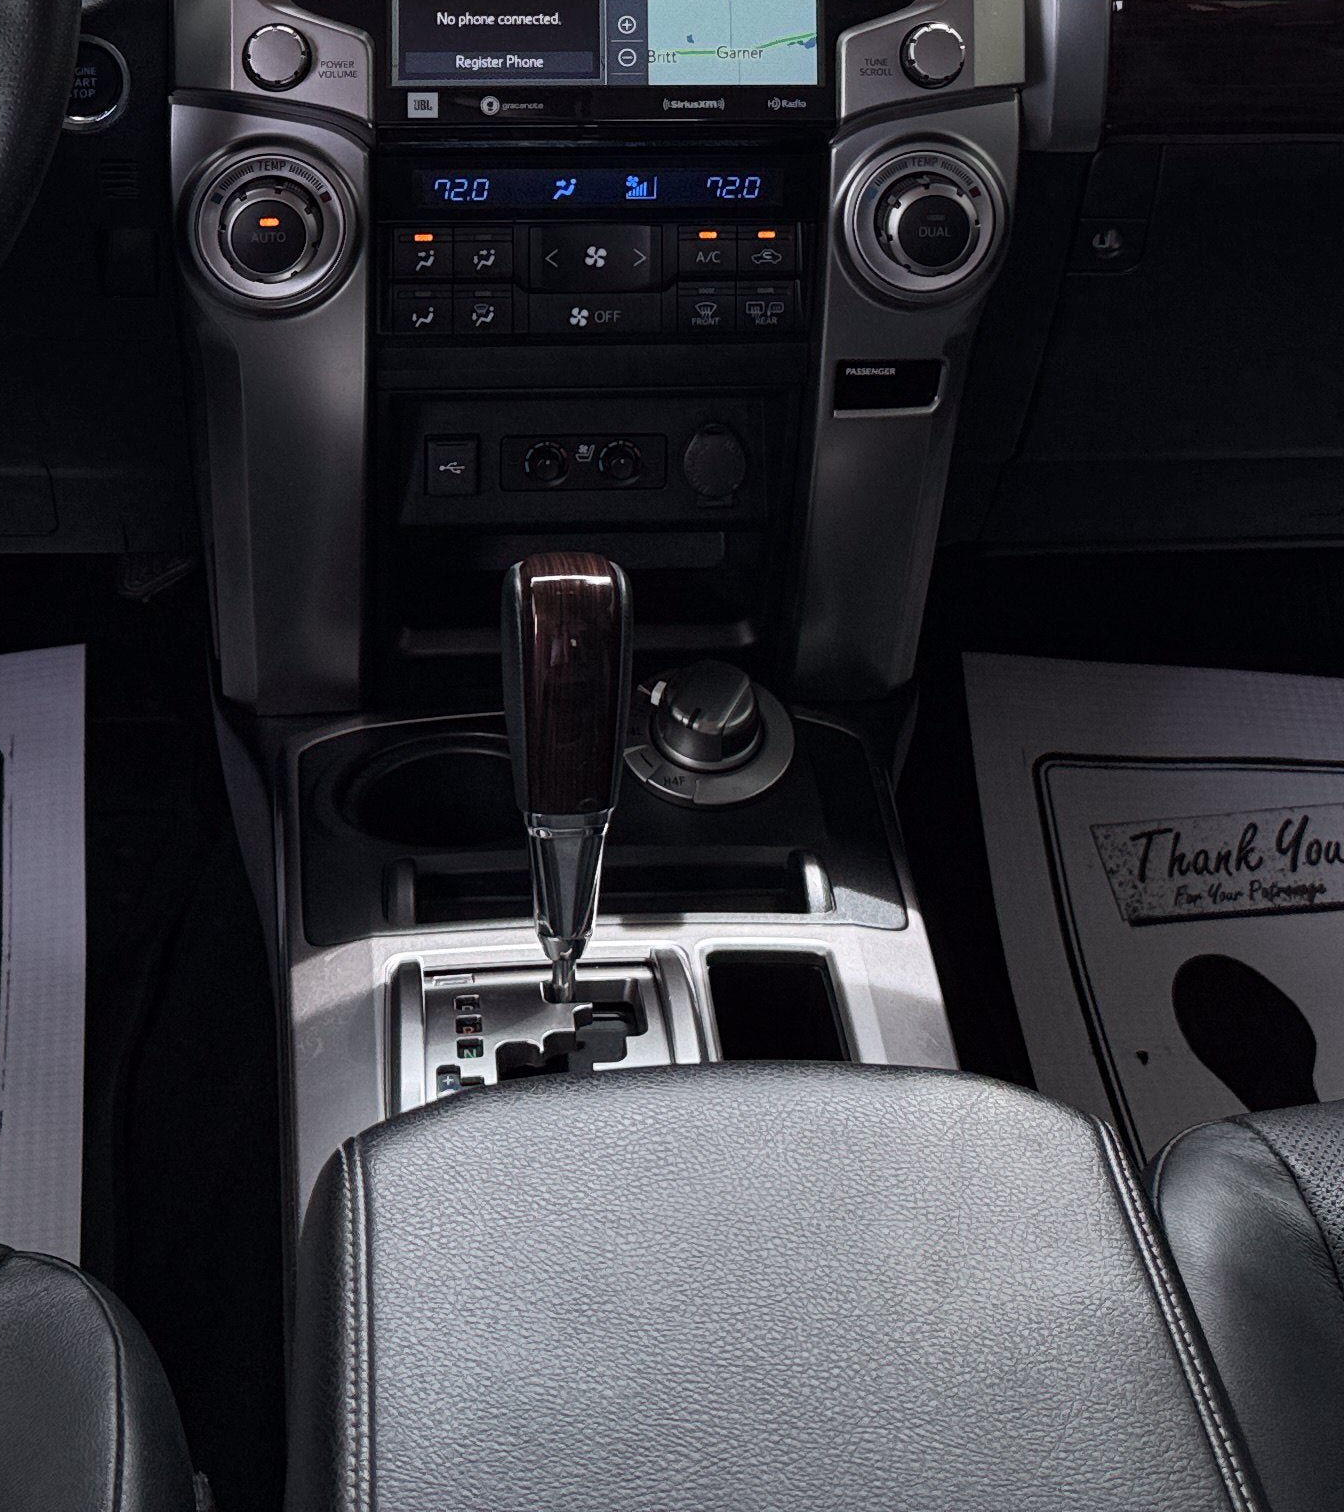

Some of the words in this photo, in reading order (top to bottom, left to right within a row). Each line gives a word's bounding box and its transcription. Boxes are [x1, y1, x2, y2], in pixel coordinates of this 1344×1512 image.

[436, 11, 456, 25] No
[458, 11, 495, 28] phone
[497, 11, 562, 26] connected.
[648, 50, 677, 64] Britt
[716, 45, 764, 60] Garner
[320, 60, 355, 69] POWER
[455, 54, 504, 71] Register
[506, 54, 544, 68] Phone
[863, 58, 888, 67] TUNE
[318, 70, 358, 79] VOLUME
[859, 67, 894, 77] SCROLL
[74, 77, 98, 88] ART
[73, 88, 96, 98] TOP
[413, 99, 433, 111] JBL
[501, 102, 544, 111] gracenote
[782, 98, 807, 108] Radio
[256, 160, 287, 171] TEMP
[911, 156, 939, 168] TEMP
[434, 178, 490, 201] 72.0
[706, 176, 761, 199] 72.0
[251, 231, 287, 243] AUTO
[918, 226, 953, 238] DUAL
[695, 251, 721, 264] A/C
[594, 310, 622, 324] OFF
[691, 316, 722, 326] FRONT
[755, 316, 778, 326] REAR
[845, 367, 896, 376] PASSENGER
[1129, 821, 1264, 884] Thank
[1174, 886, 1202, 907] For
[1206, 884, 1244, 903] Your
